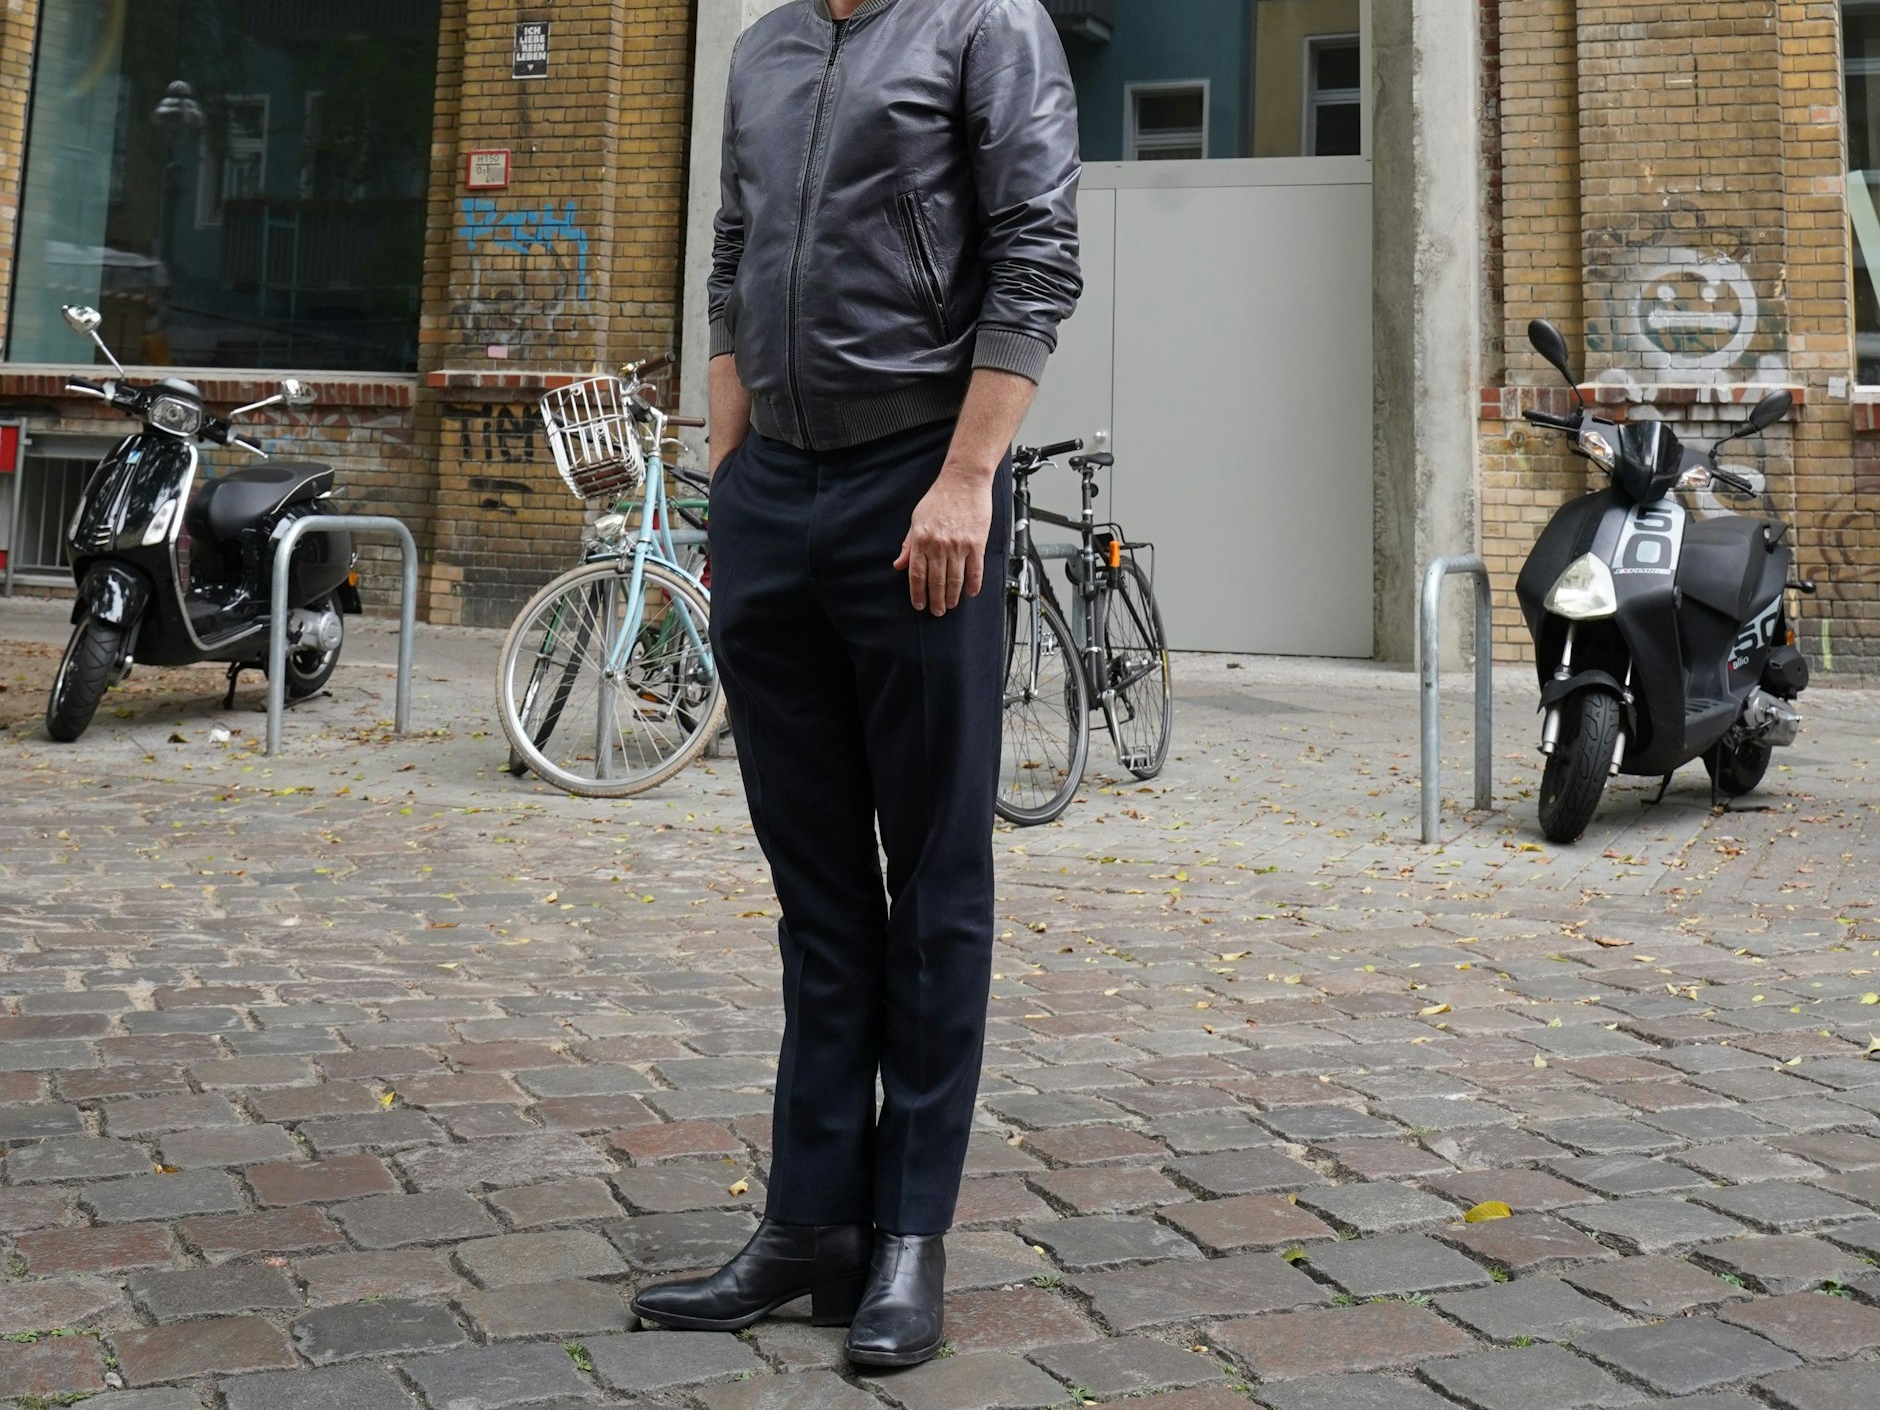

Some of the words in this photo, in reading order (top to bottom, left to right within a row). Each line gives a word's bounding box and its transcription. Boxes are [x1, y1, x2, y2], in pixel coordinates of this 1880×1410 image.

[523, 26, 542, 35] ICH
[519, 35, 546, 44] LIEBE
[515, 51, 547, 62] LEBEN
